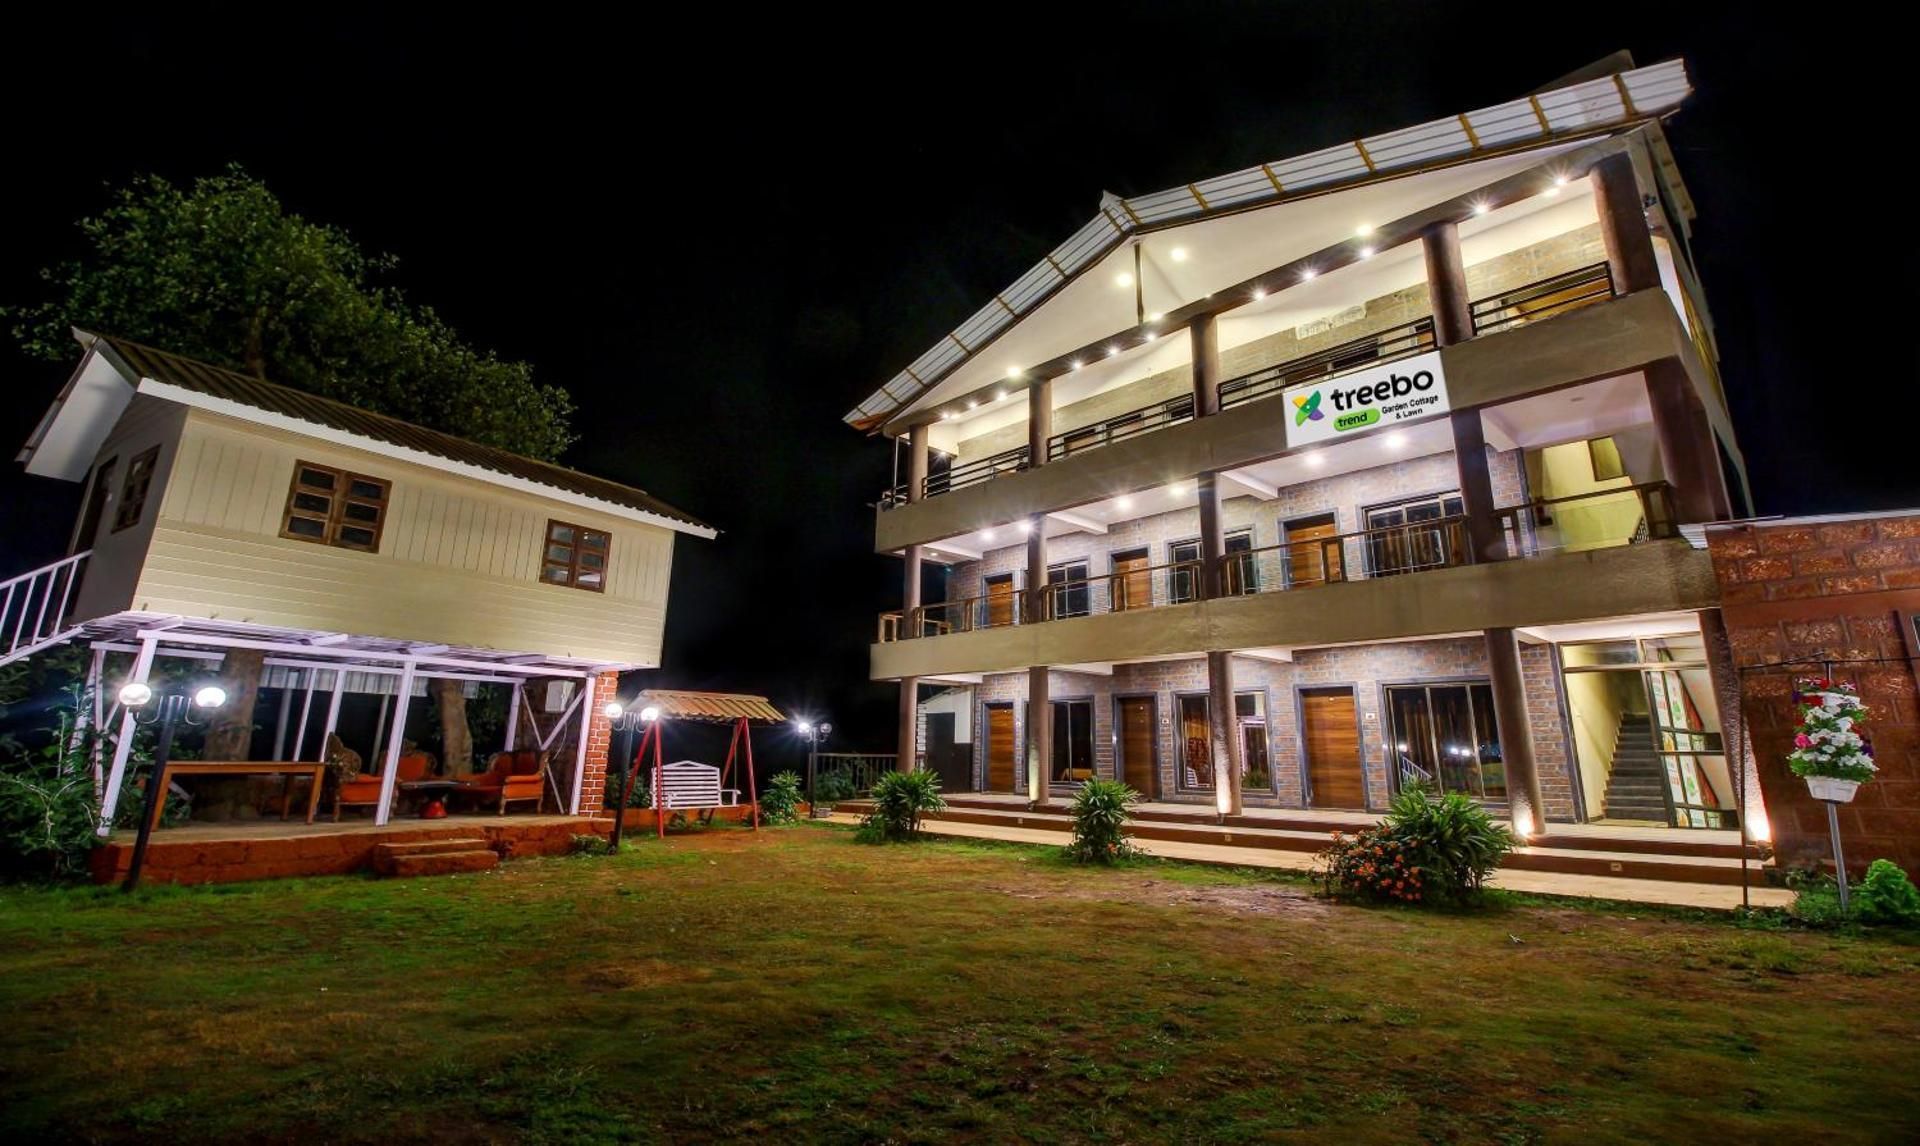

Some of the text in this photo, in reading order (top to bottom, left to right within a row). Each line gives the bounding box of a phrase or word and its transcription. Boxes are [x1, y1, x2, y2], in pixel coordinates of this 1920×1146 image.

[1330, 370, 1434, 411] treebo
[1382, 395, 1438, 414] Garden Cottage
[1402, 408, 1423, 418] Lawn
[1338, 412, 1368, 427] trend
